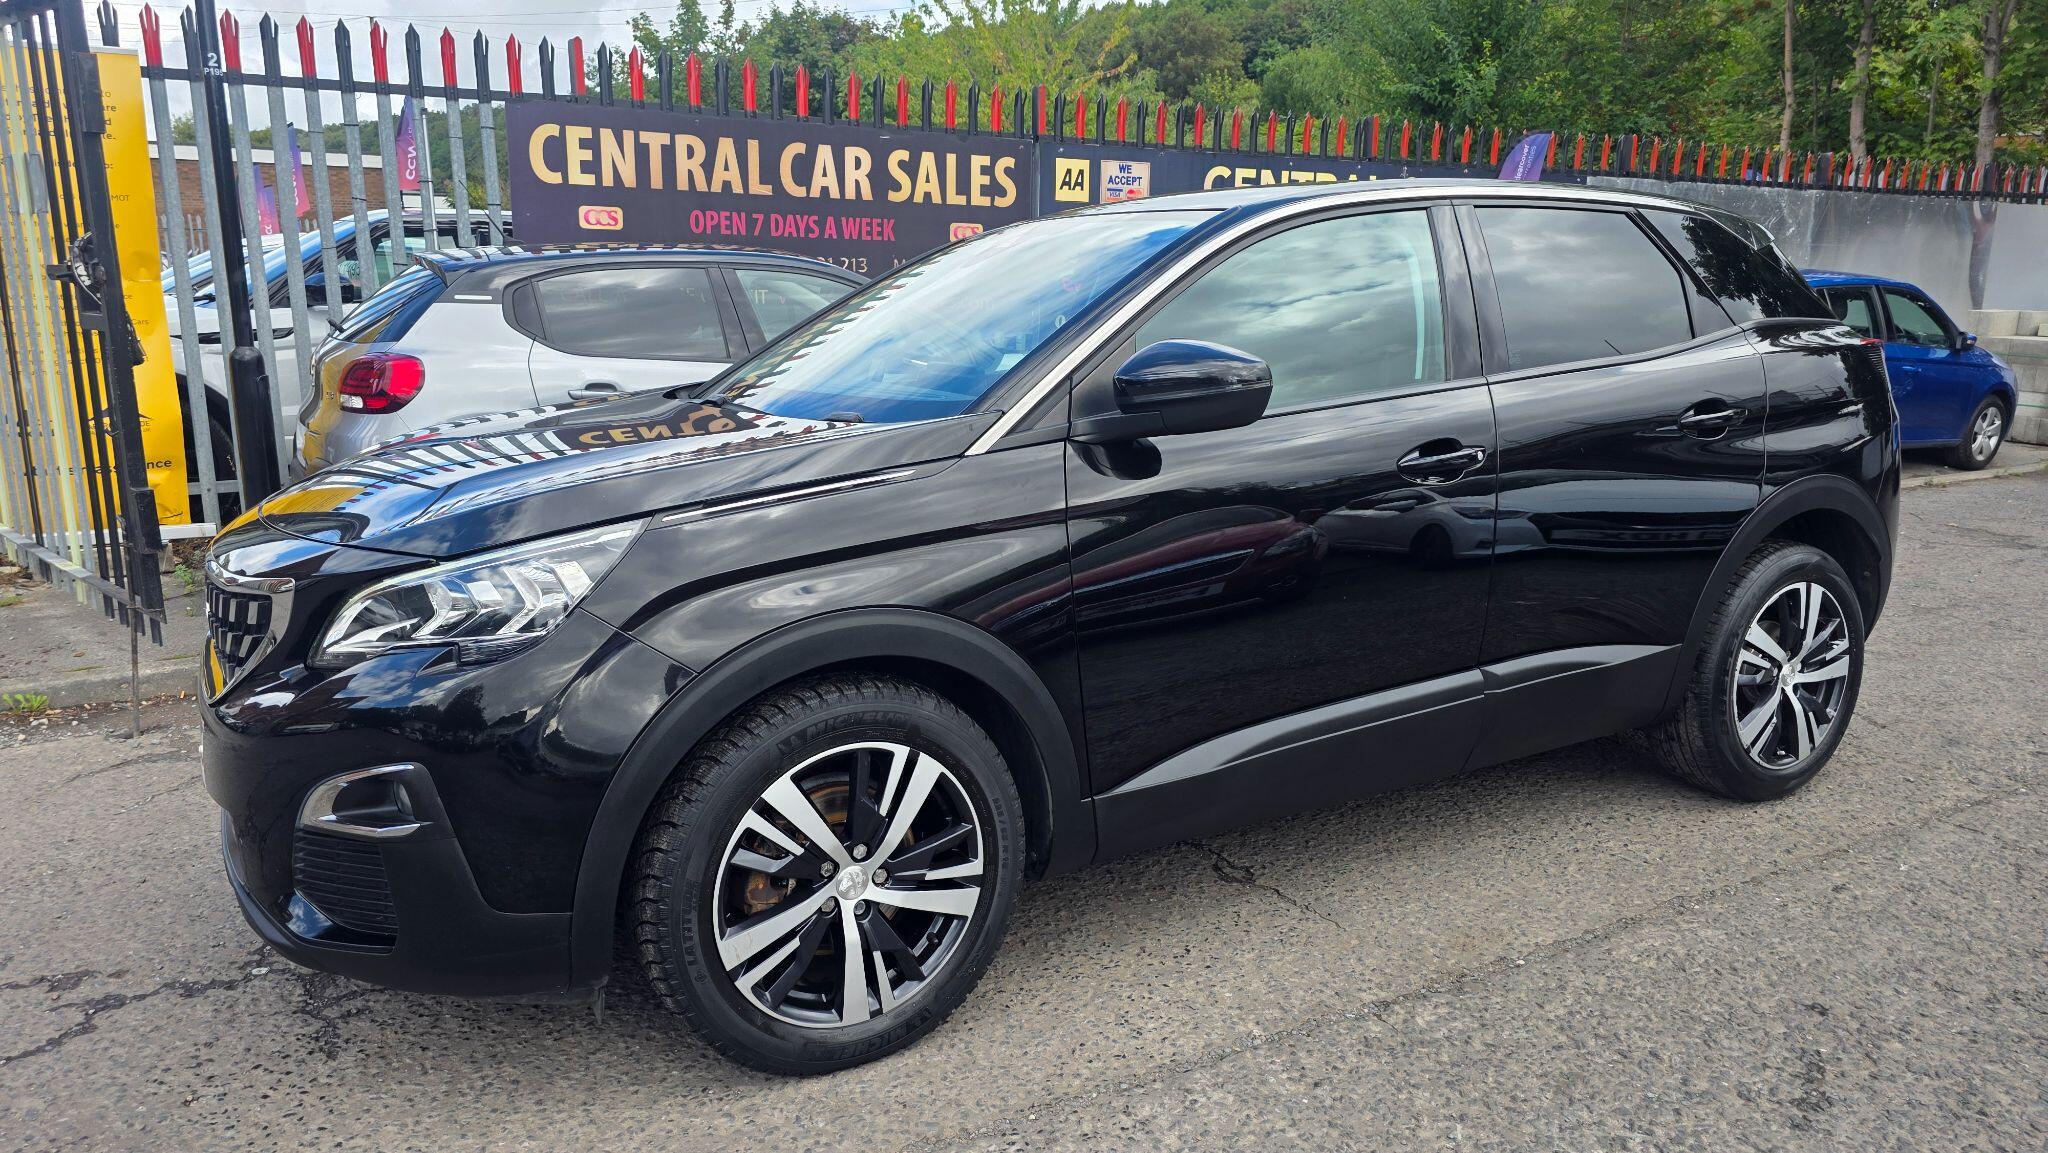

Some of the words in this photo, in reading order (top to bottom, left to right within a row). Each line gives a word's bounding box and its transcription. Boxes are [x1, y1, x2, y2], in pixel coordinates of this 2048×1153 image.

[207, 52, 218, 67] 2
[528, 123, 773, 196] CENTRAL
[779, 142, 874, 201] CAR
[887, 149, 1017, 208] SALES
[1118, 163, 1132, 174] WE
[1059, 168, 1085, 191] AA
[1107, 176, 1142, 186] ACCEPT
[689, 209, 747, 236] OPEN
[752, 213, 765, 237] 7
[770, 213, 819, 239] DAYS
[824, 216, 838, 239] A
[841, 217, 896, 242] WEEK
[840, 257, 868, 273] 213
